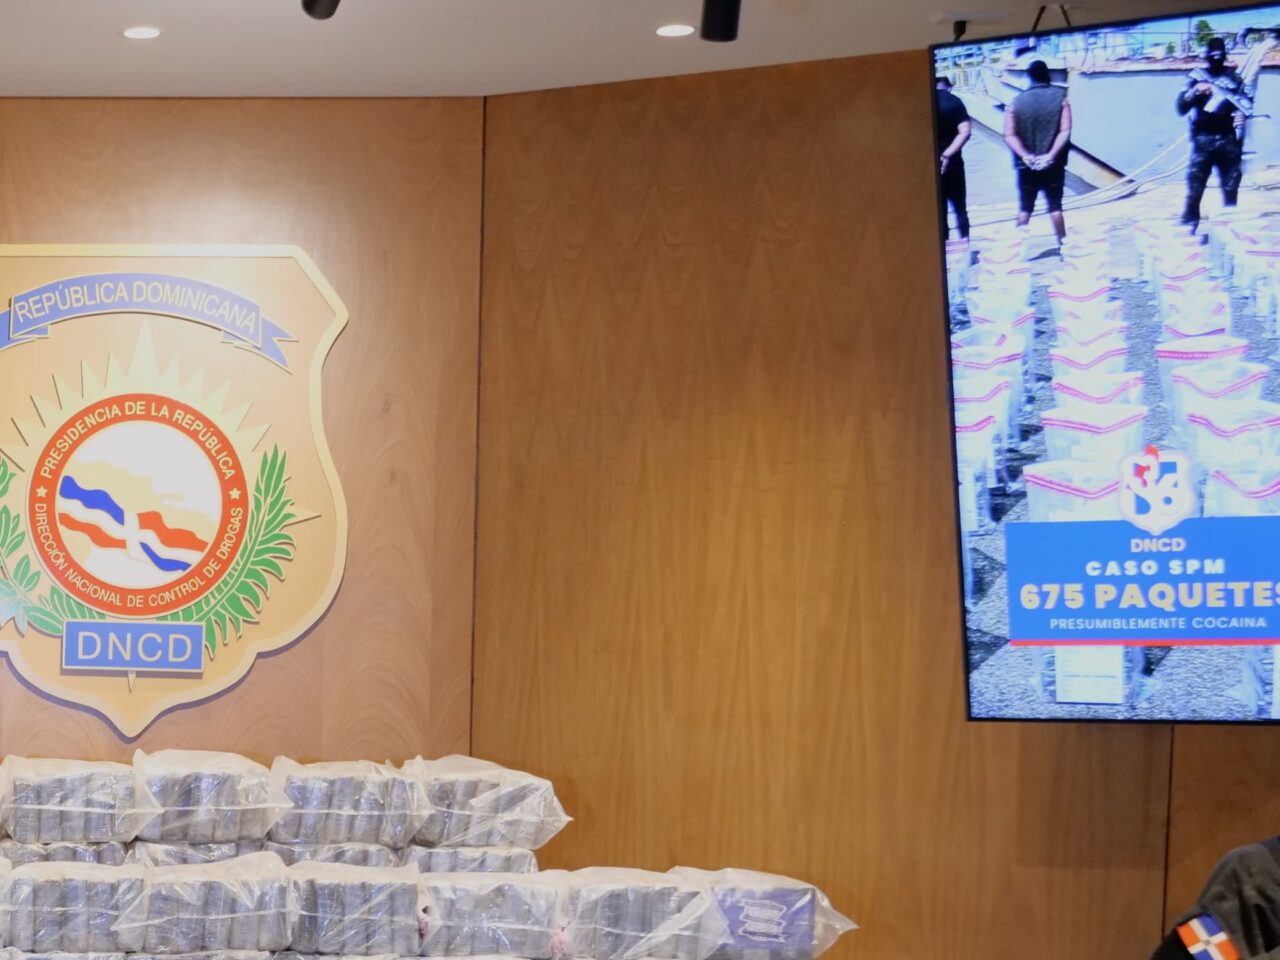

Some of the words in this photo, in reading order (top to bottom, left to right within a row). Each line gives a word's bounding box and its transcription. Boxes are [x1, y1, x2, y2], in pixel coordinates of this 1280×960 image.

[15, 282, 128, 323] REPÚBLICA
[132, 281, 256, 331] DOMINICANA
[40, 404, 122, 479] PRESIDENCIA
[124, 401, 146, 416] DE
[150, 403, 169, 419] LA
[172, 409, 236, 480] REPÚBLICA
[35, 503, 67, 571] DIRECCIÓN
[64, 568, 122, 606] NACIONAL
[127, 595, 144, 608] DE
[148, 577, 206, 608] CONTROL
[202, 558, 221, 579] DE
[216, 506, 244, 561] DROGAS
[1130, 538, 1186, 553] DNCD
[1085, 560, 1158, 577] CASO
[1169, 559, 1225, 575] SPM
[1020, 583, 1085, 610] 675
[1050, 618, 1187, 630] PRESUMIBLEMENTE
[78, 631, 192, 662] DNCD
